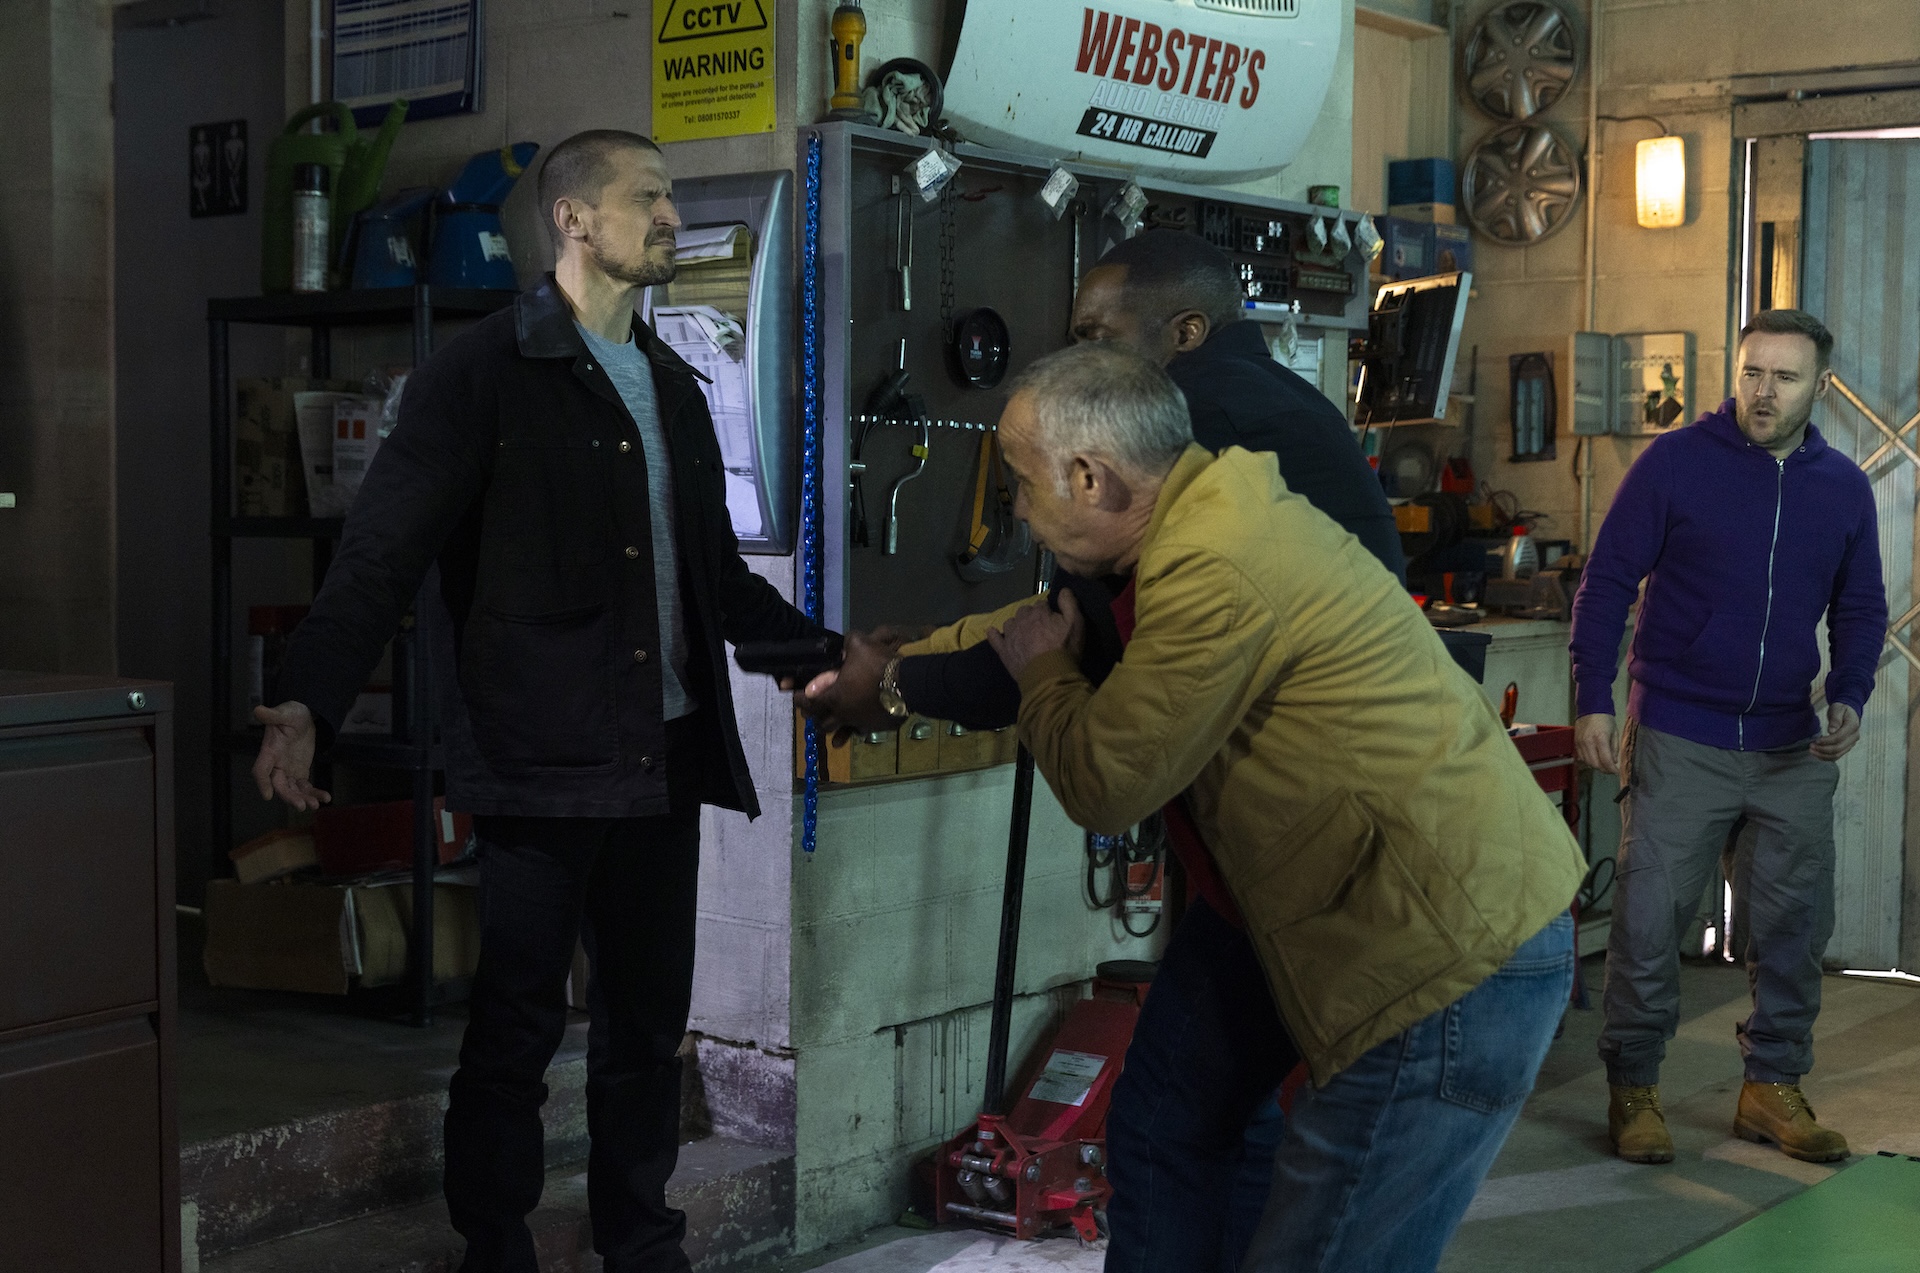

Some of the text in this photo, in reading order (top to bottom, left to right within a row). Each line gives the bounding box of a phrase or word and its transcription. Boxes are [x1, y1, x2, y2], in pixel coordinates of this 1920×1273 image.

[683, 2, 741, 30] CCTV
[663, 47, 764, 80] WARNING
[1074, 7, 1266, 110] WEBSTER'S
[669, 100, 684, 108] crime
[685, 97, 715, 107] prevention
[729, 92, 757, 101] detection
[693, 86, 719, 96] recorded
[1088, 79, 1228, 129] AUTO CENTRE
[1090, 112, 1206, 153] 24 HR CALLOUT
